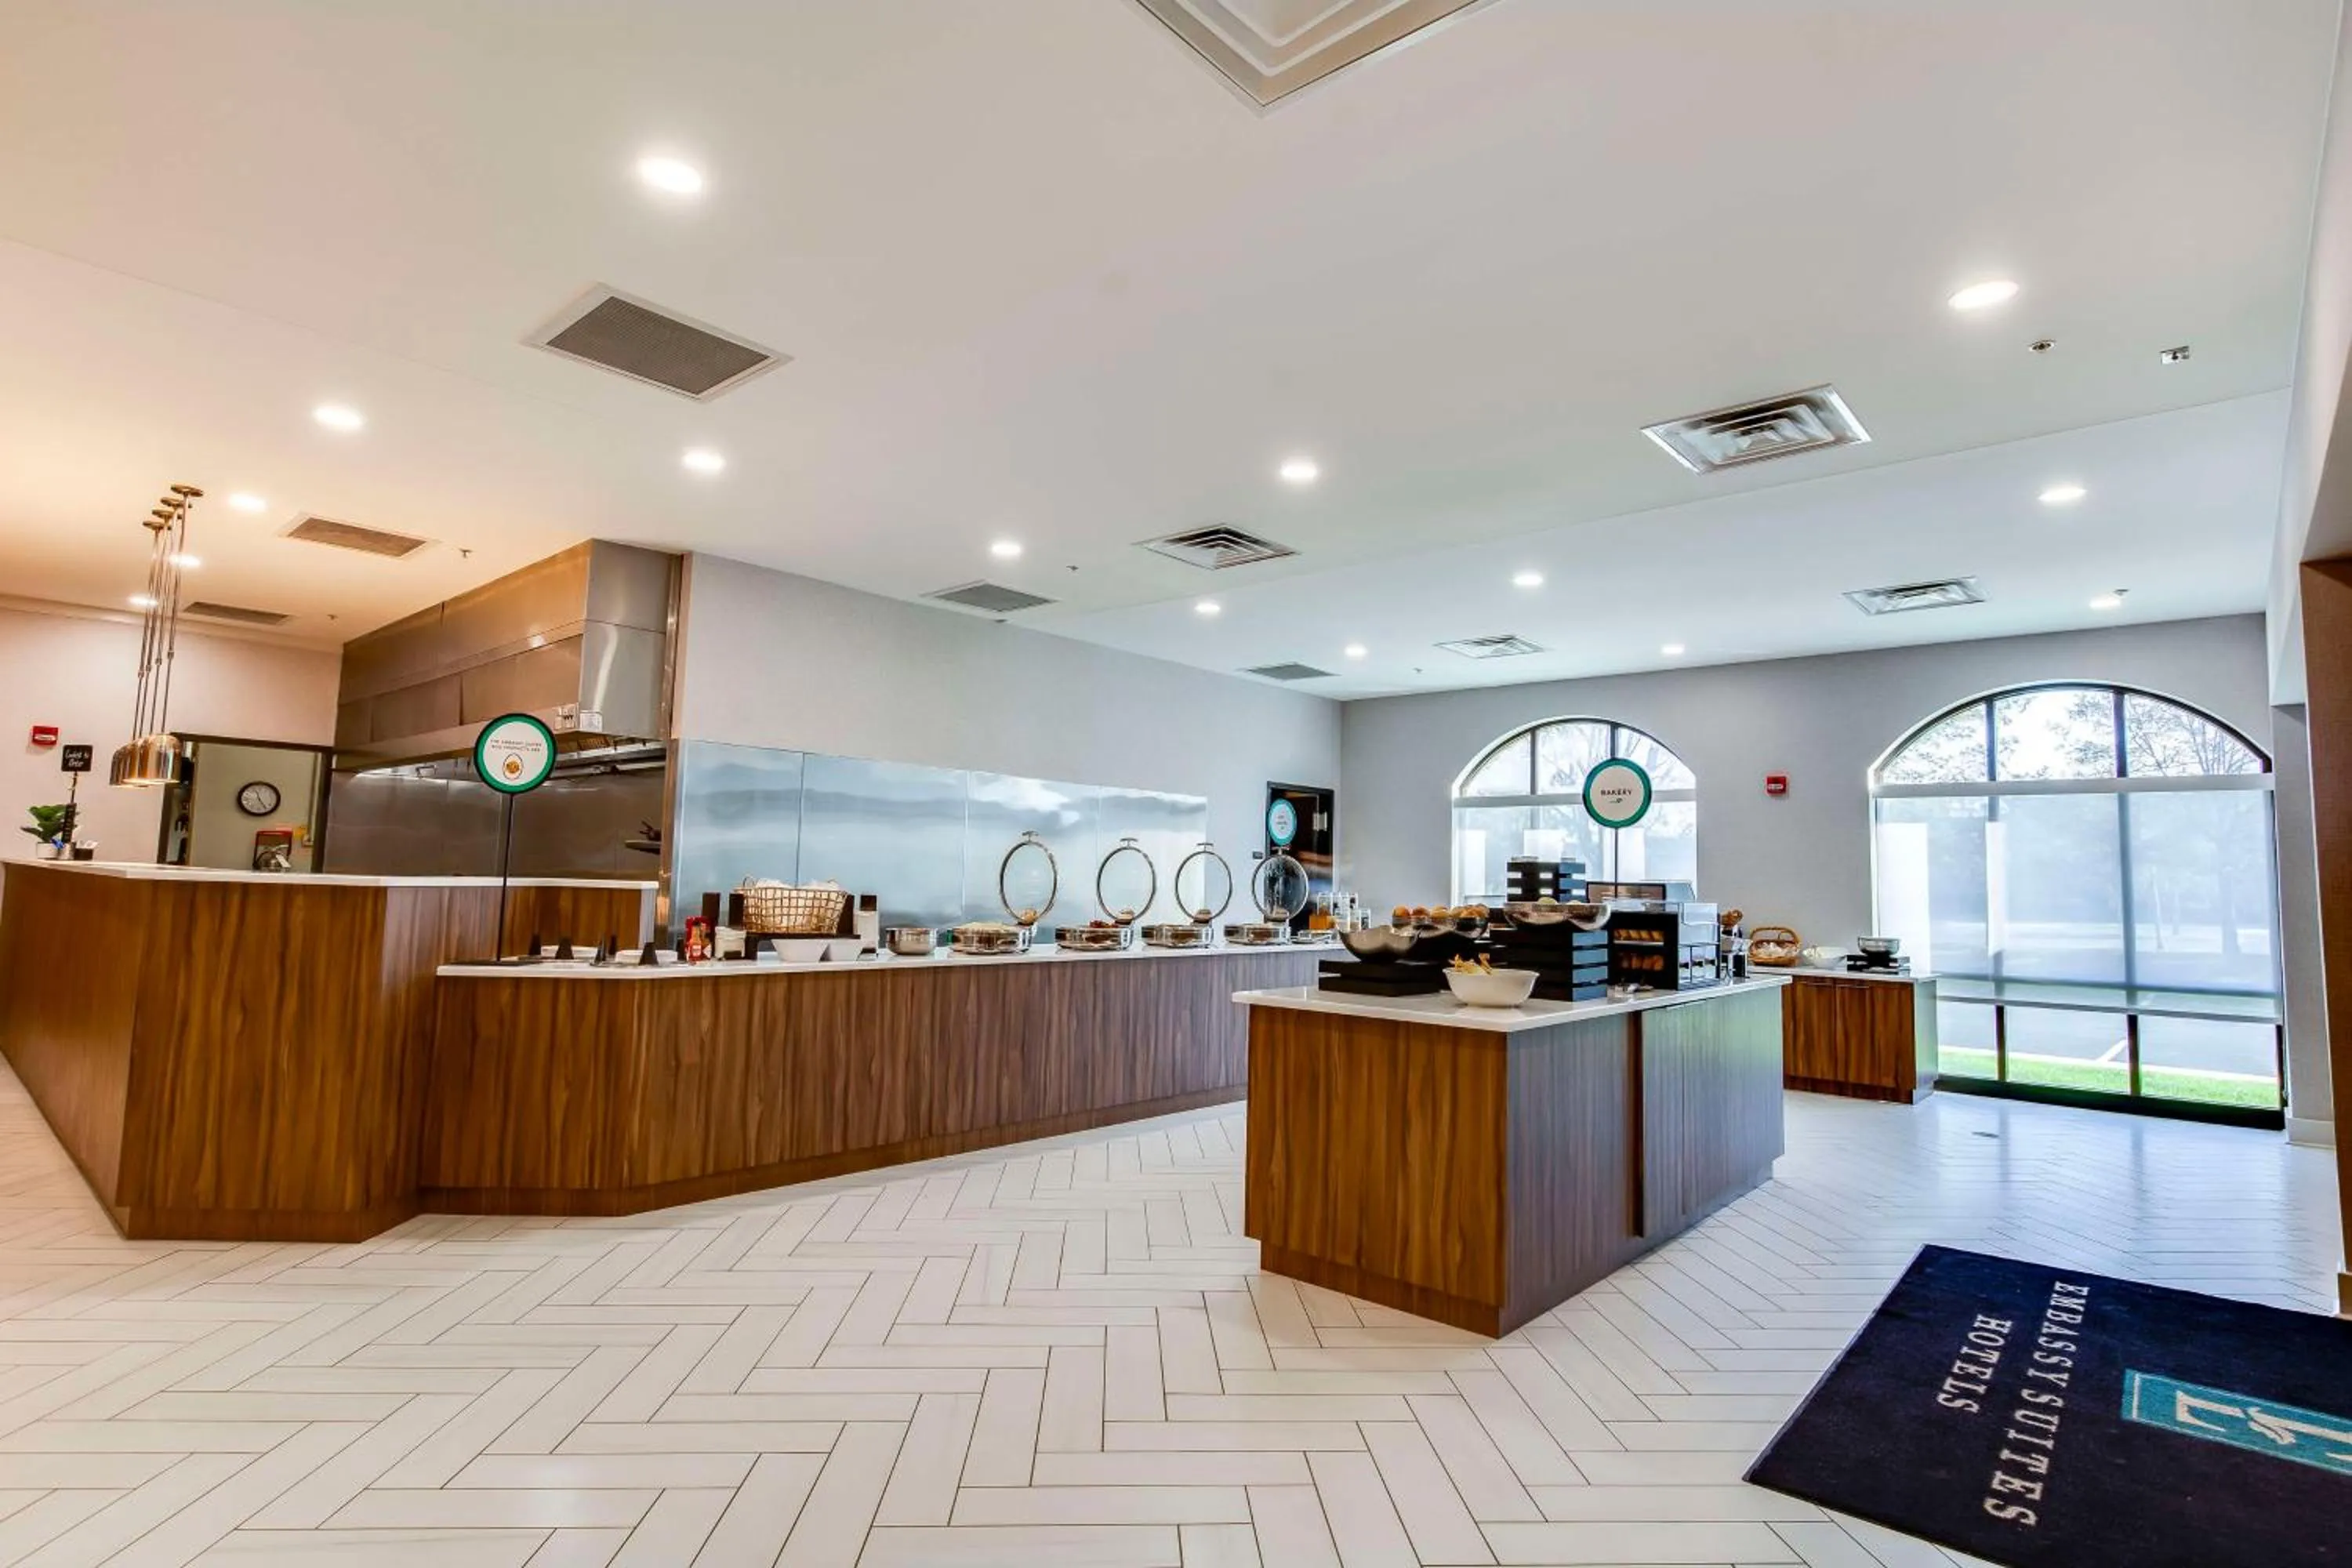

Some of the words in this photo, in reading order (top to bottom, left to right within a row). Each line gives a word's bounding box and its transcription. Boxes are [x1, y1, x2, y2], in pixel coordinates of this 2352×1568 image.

[1936, 1313, 2013, 1414] HOTELS
[2027, 1280, 2090, 1388] EMBASSY
[1983, 1388, 2065, 1526] SUITES
